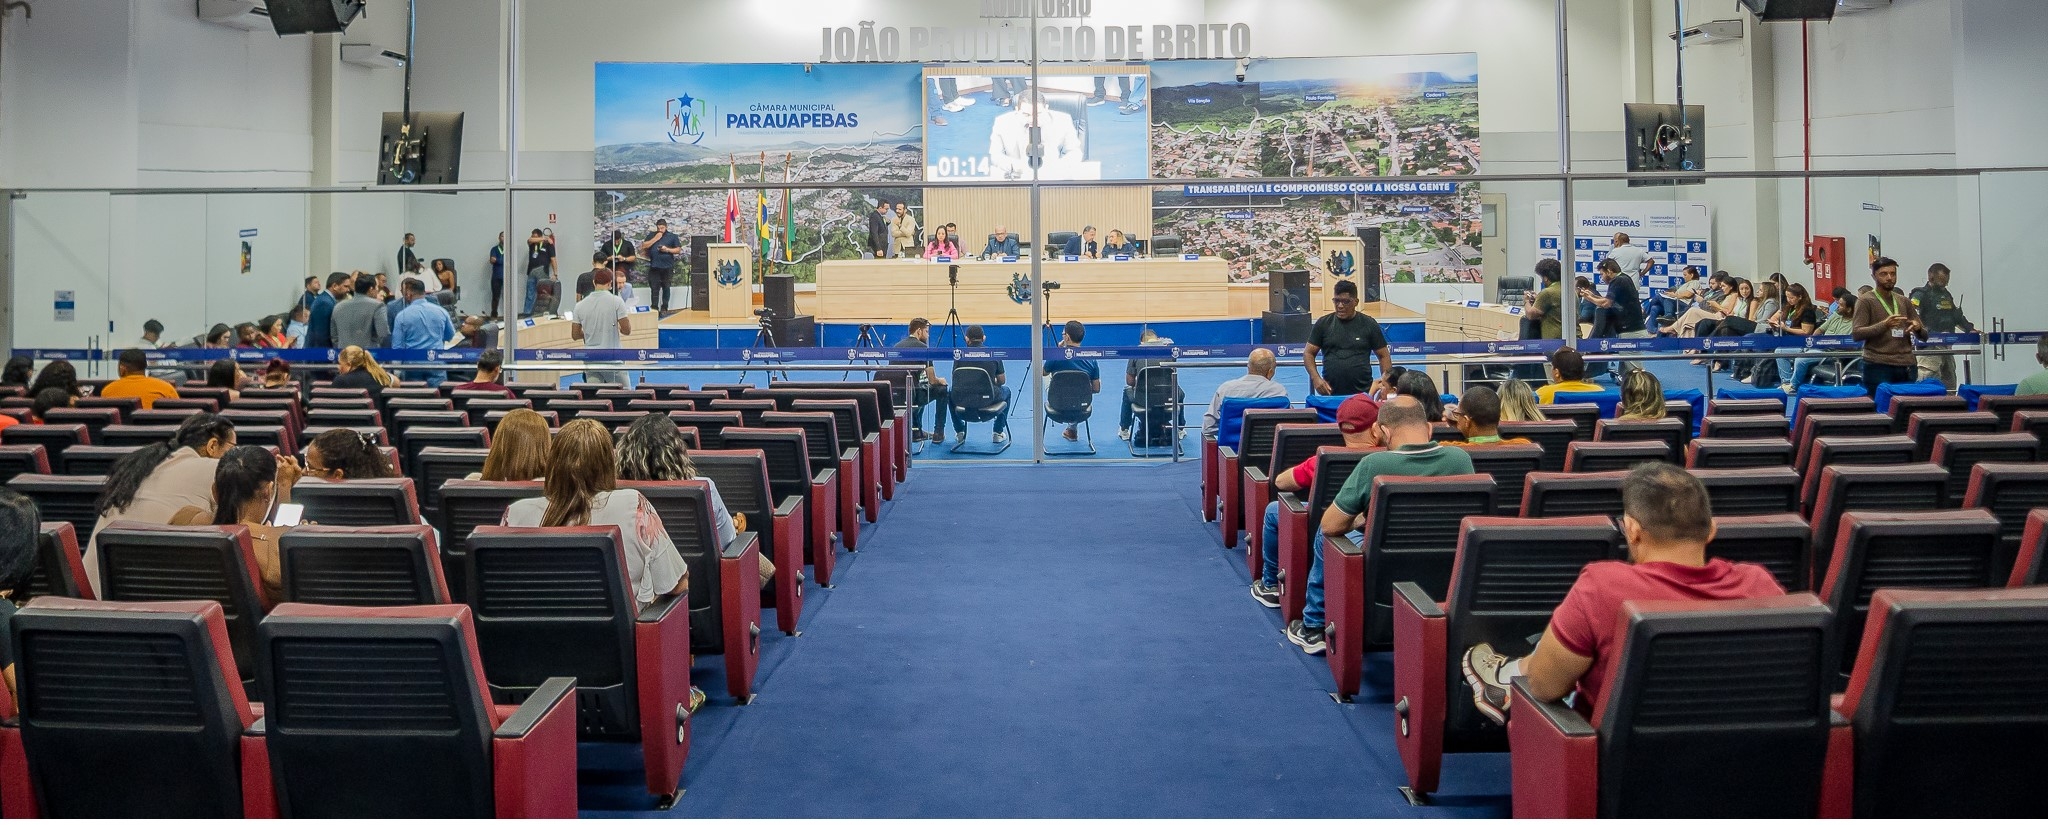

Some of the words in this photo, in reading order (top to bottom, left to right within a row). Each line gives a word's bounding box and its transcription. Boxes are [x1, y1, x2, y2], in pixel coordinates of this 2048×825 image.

[819, 20, 900, 62] JOÃO
[909, 19, 1096, 62] PRUDÊNCIO
[1104, 25, 1143, 60] DE
[1152, 22, 1251, 59] BRITO
[749, 103, 788, 112] CÂMARA
[789, 103, 836, 112] MUNICIPAL
[726, 112, 859, 129] PARAUAPEBAS
[938, 156, 990, 177] 01:14
[1188, 183, 1265, 194] TRANSPARÊNCIA
[1266, 184, 1272, 193] E
[1273, 183, 1348, 193] COMPROMISSO
[1348, 182, 1373, 192] COM
[1374, 183, 1383, 192] A
[1383, 182, 1417, 192] NOSSA
[1418, 181, 1450, 191] GENTE
[1582, 219, 1641, 228] PARAUAPEBAS
